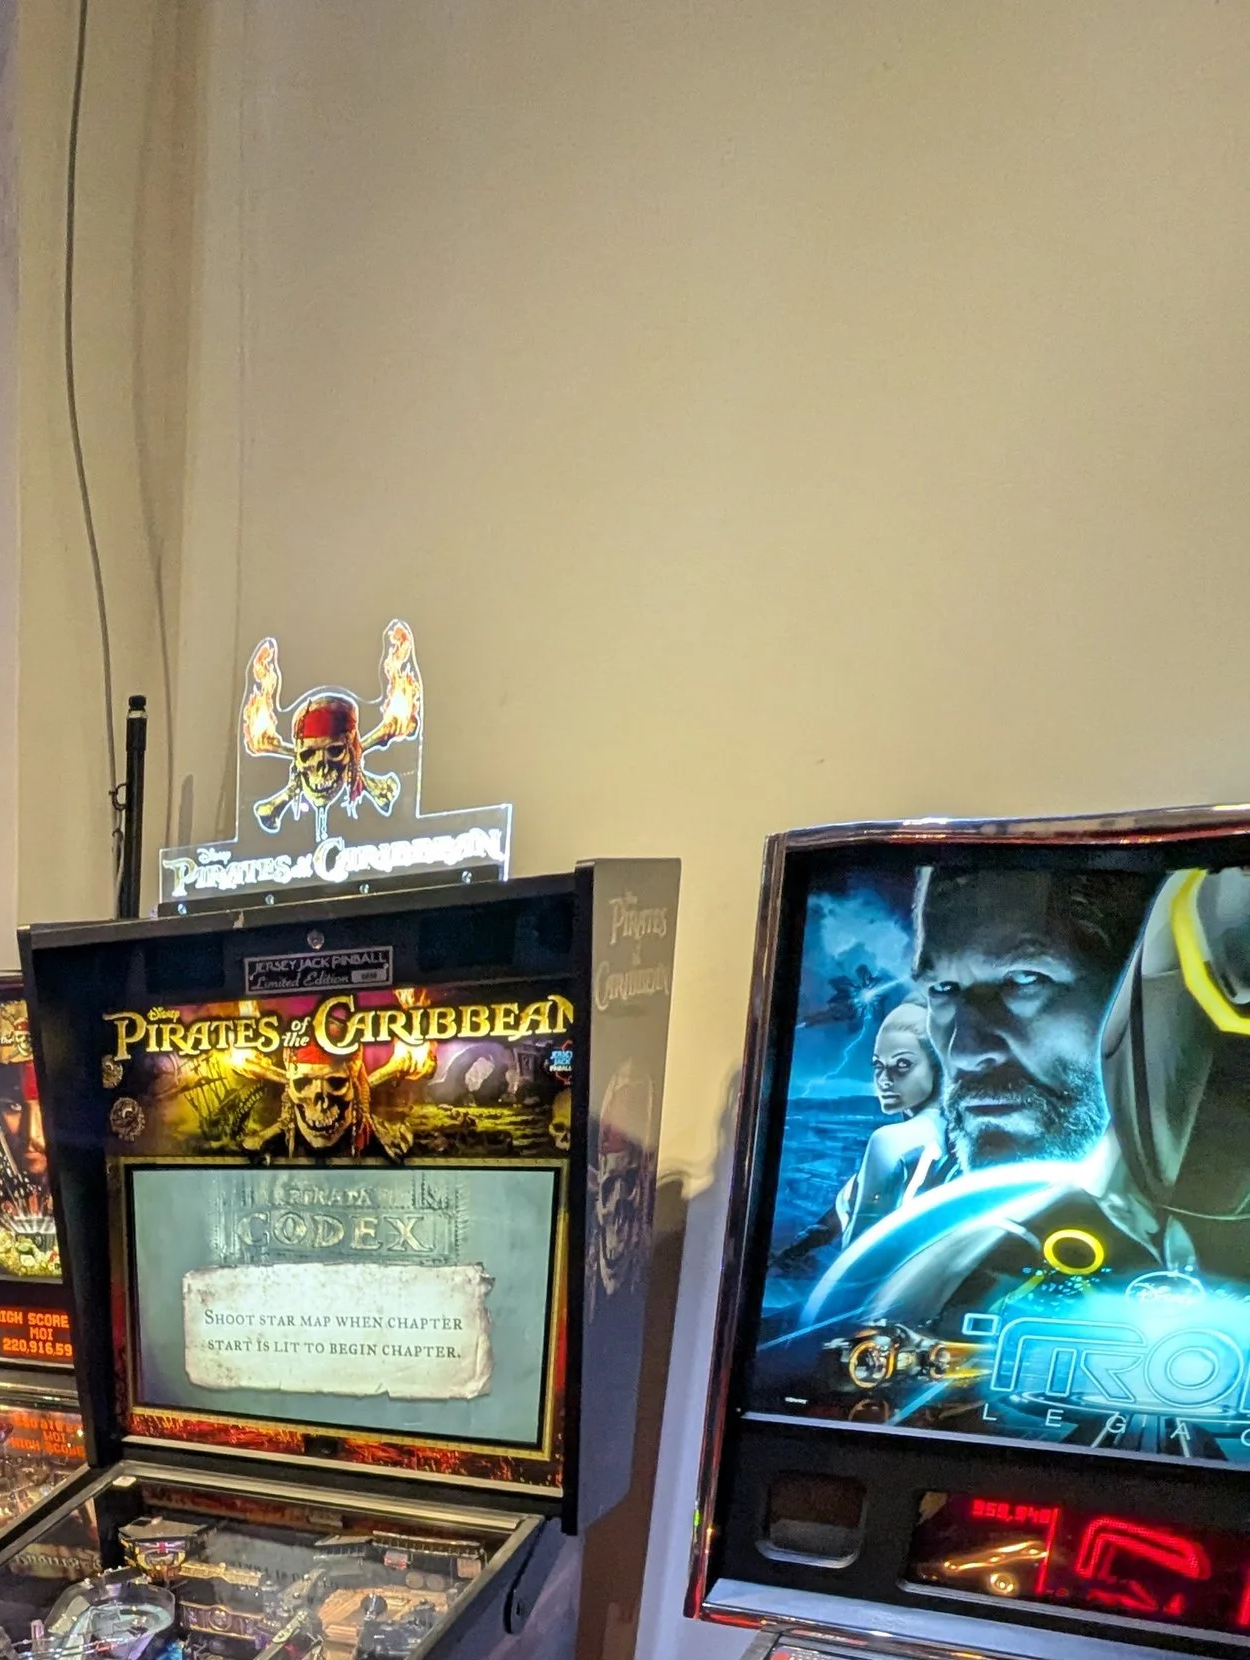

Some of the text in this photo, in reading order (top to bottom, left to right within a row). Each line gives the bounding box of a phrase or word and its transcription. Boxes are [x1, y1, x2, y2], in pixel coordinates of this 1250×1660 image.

[162, 856, 292, 896] PIRATES
[250, 951, 388, 981] JERSEY JACK PINBALL
[251, 971, 300, 990] Limited
[303, 970, 349, 986] Edition
[291, 1016, 310, 1034] of
[101, 1010, 281, 1062] PIRATES
[281, 1032, 310, 1048] the
[235, 1210, 434, 1253] CODEX
[27, 1313, 70, 1328] SCORE
[259, 1312, 296, 1327] STAR
[299, 1313, 332, 1329] MAP
[335, 1314, 384, 1330] WHEN
[386, 1315, 463, 1332] CHAPTER
[29, 1327, 54, 1341] MOI
[207, 1339, 462, 1359] START IS LIT TO BEGIN CHAPTER.
[962, 1312, 1250, 1414] TRO
